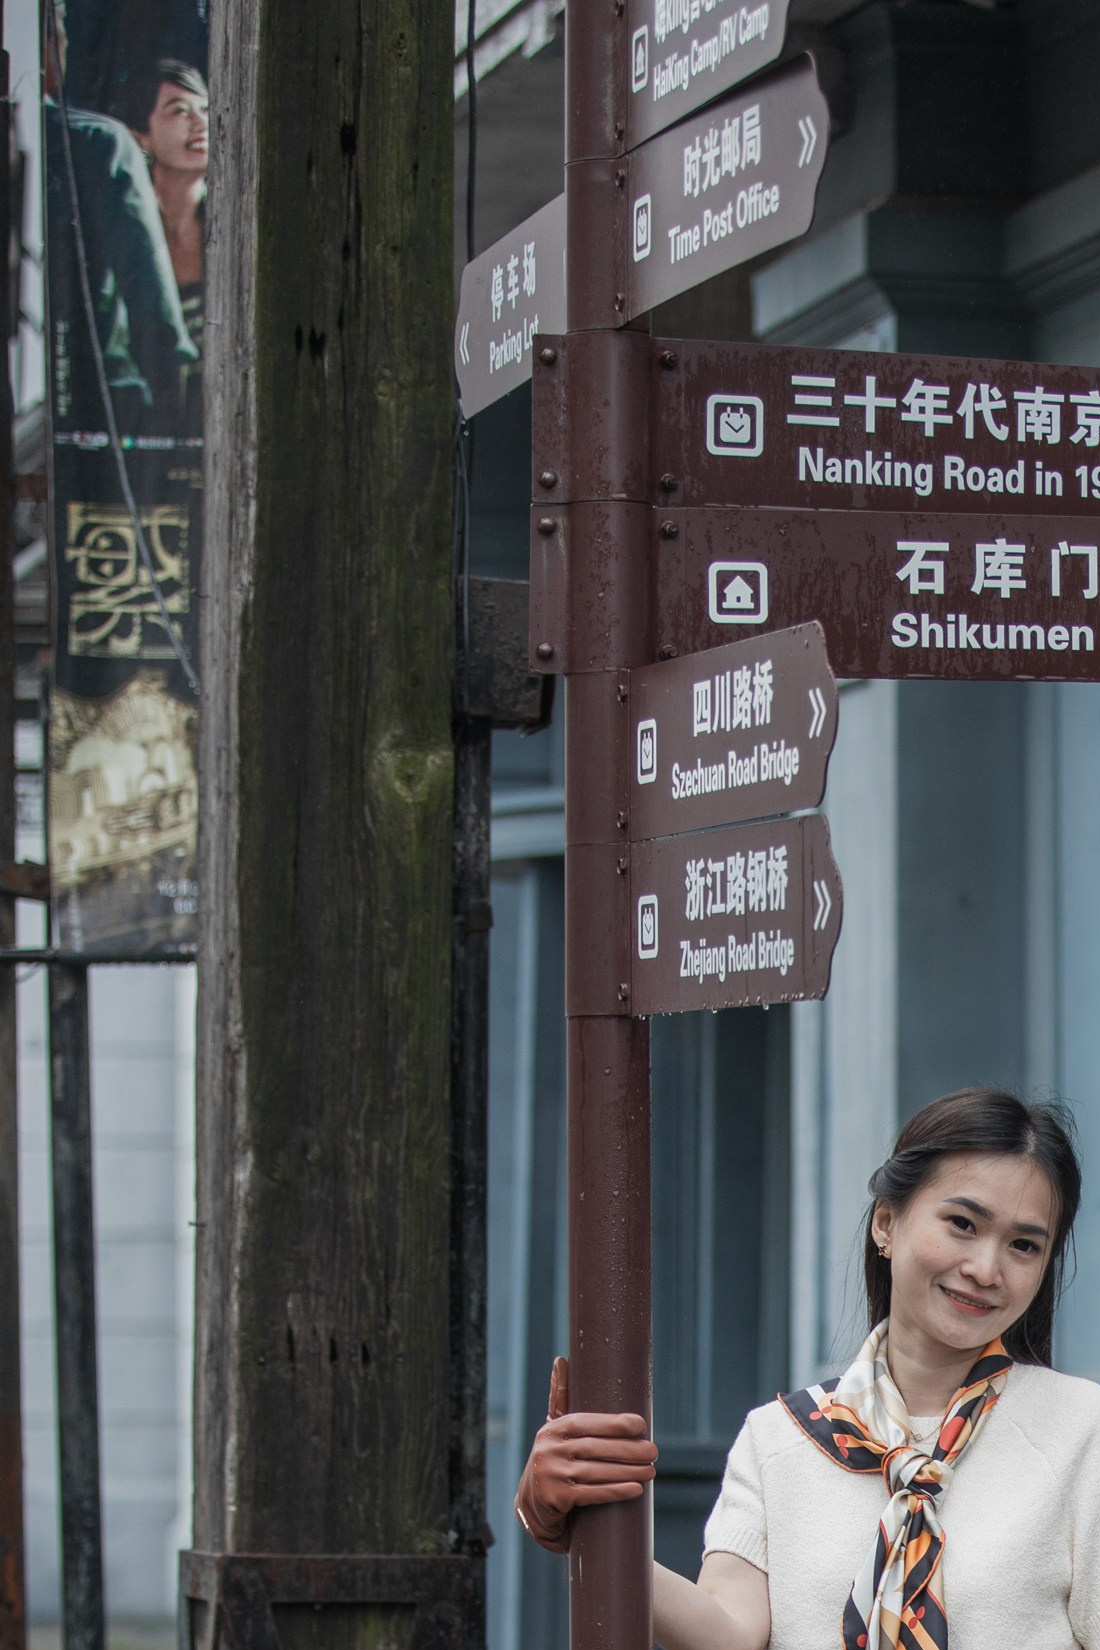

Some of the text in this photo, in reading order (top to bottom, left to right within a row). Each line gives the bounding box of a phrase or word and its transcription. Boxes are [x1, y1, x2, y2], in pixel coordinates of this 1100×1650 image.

[653, 51, 690, 102] HaiKing
[739, 3, 769, 46] Camp
[683, 104, 762, 198] 时光邮局
[668, 182, 780, 264] Time Post Office
[491, 241, 536, 323] 停车场
[489, 313, 539, 375] Parking Lot
[798, 446, 934, 497] Nanking
[943, 455, 1026, 495] Road
[1034, 460, 1064, 498] in
[896, 539, 1100, 600] 石库门
[891, 612, 1095, 652] Shikumen
[692, 659, 774, 738] 四川路桥
[671, 738, 800, 800] Szechuan Road Bridge
[684, 845, 789, 921] 浙江路钢桥
[679, 929, 795, 985] Zhejiang Road Bridge
